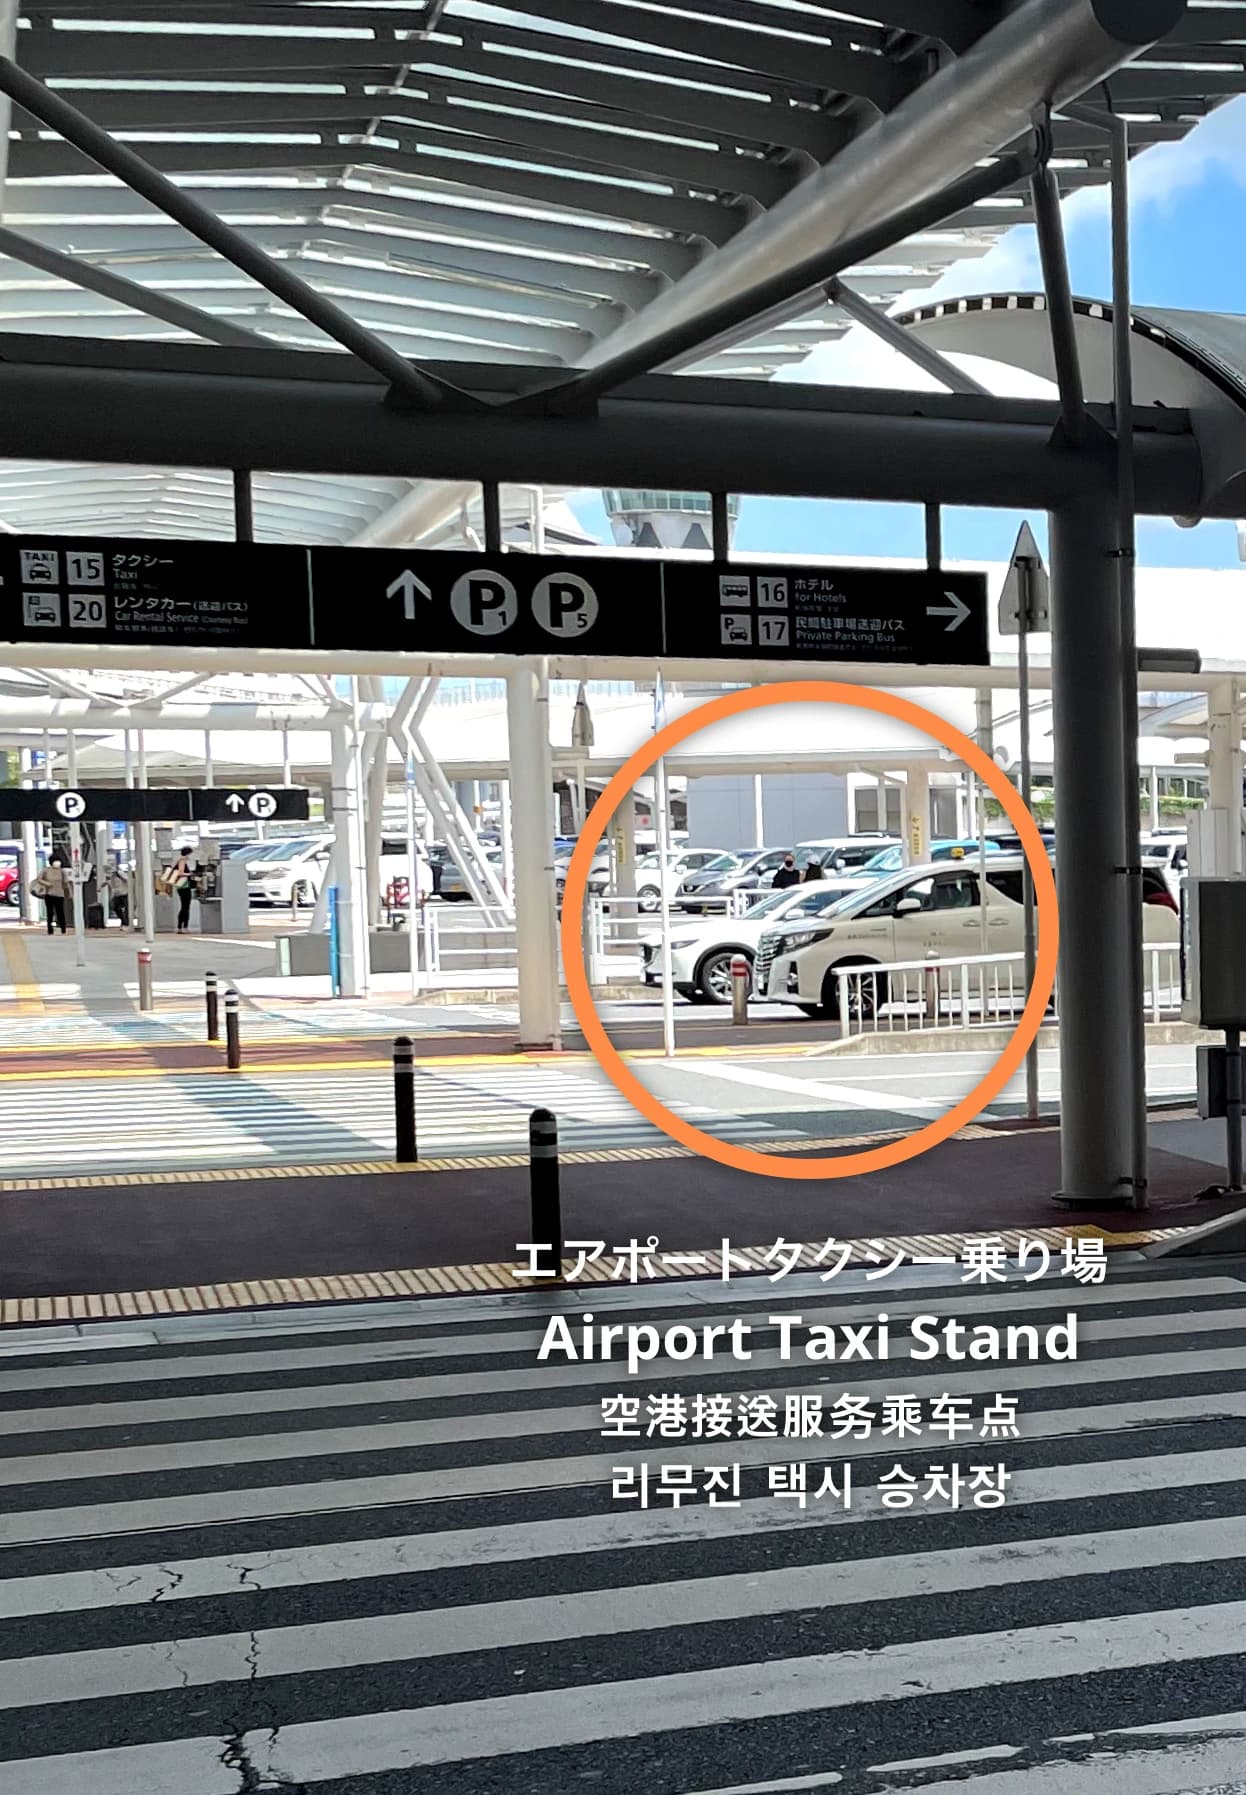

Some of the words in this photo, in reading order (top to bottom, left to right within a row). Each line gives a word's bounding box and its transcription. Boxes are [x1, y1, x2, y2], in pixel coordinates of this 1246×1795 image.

[24, 551, 55, 562] TAXI
[112, 553, 174, 567] タクシー
[72, 558, 100, 580] 15
[112, 568, 138, 580] Taxi
[760, 582, 785, 602] 16
[794, 578, 835, 592] ホテル
[795, 592, 810, 603] for
[813, 592, 847, 604] Hotels
[73, 600, 103, 622] 20
[724, 617, 735, 630] P
[762, 620, 787, 641] 17
[796, 630, 833, 641] Private
[835, 631, 875, 645] Parking
[876, 631, 896, 643] Bus
